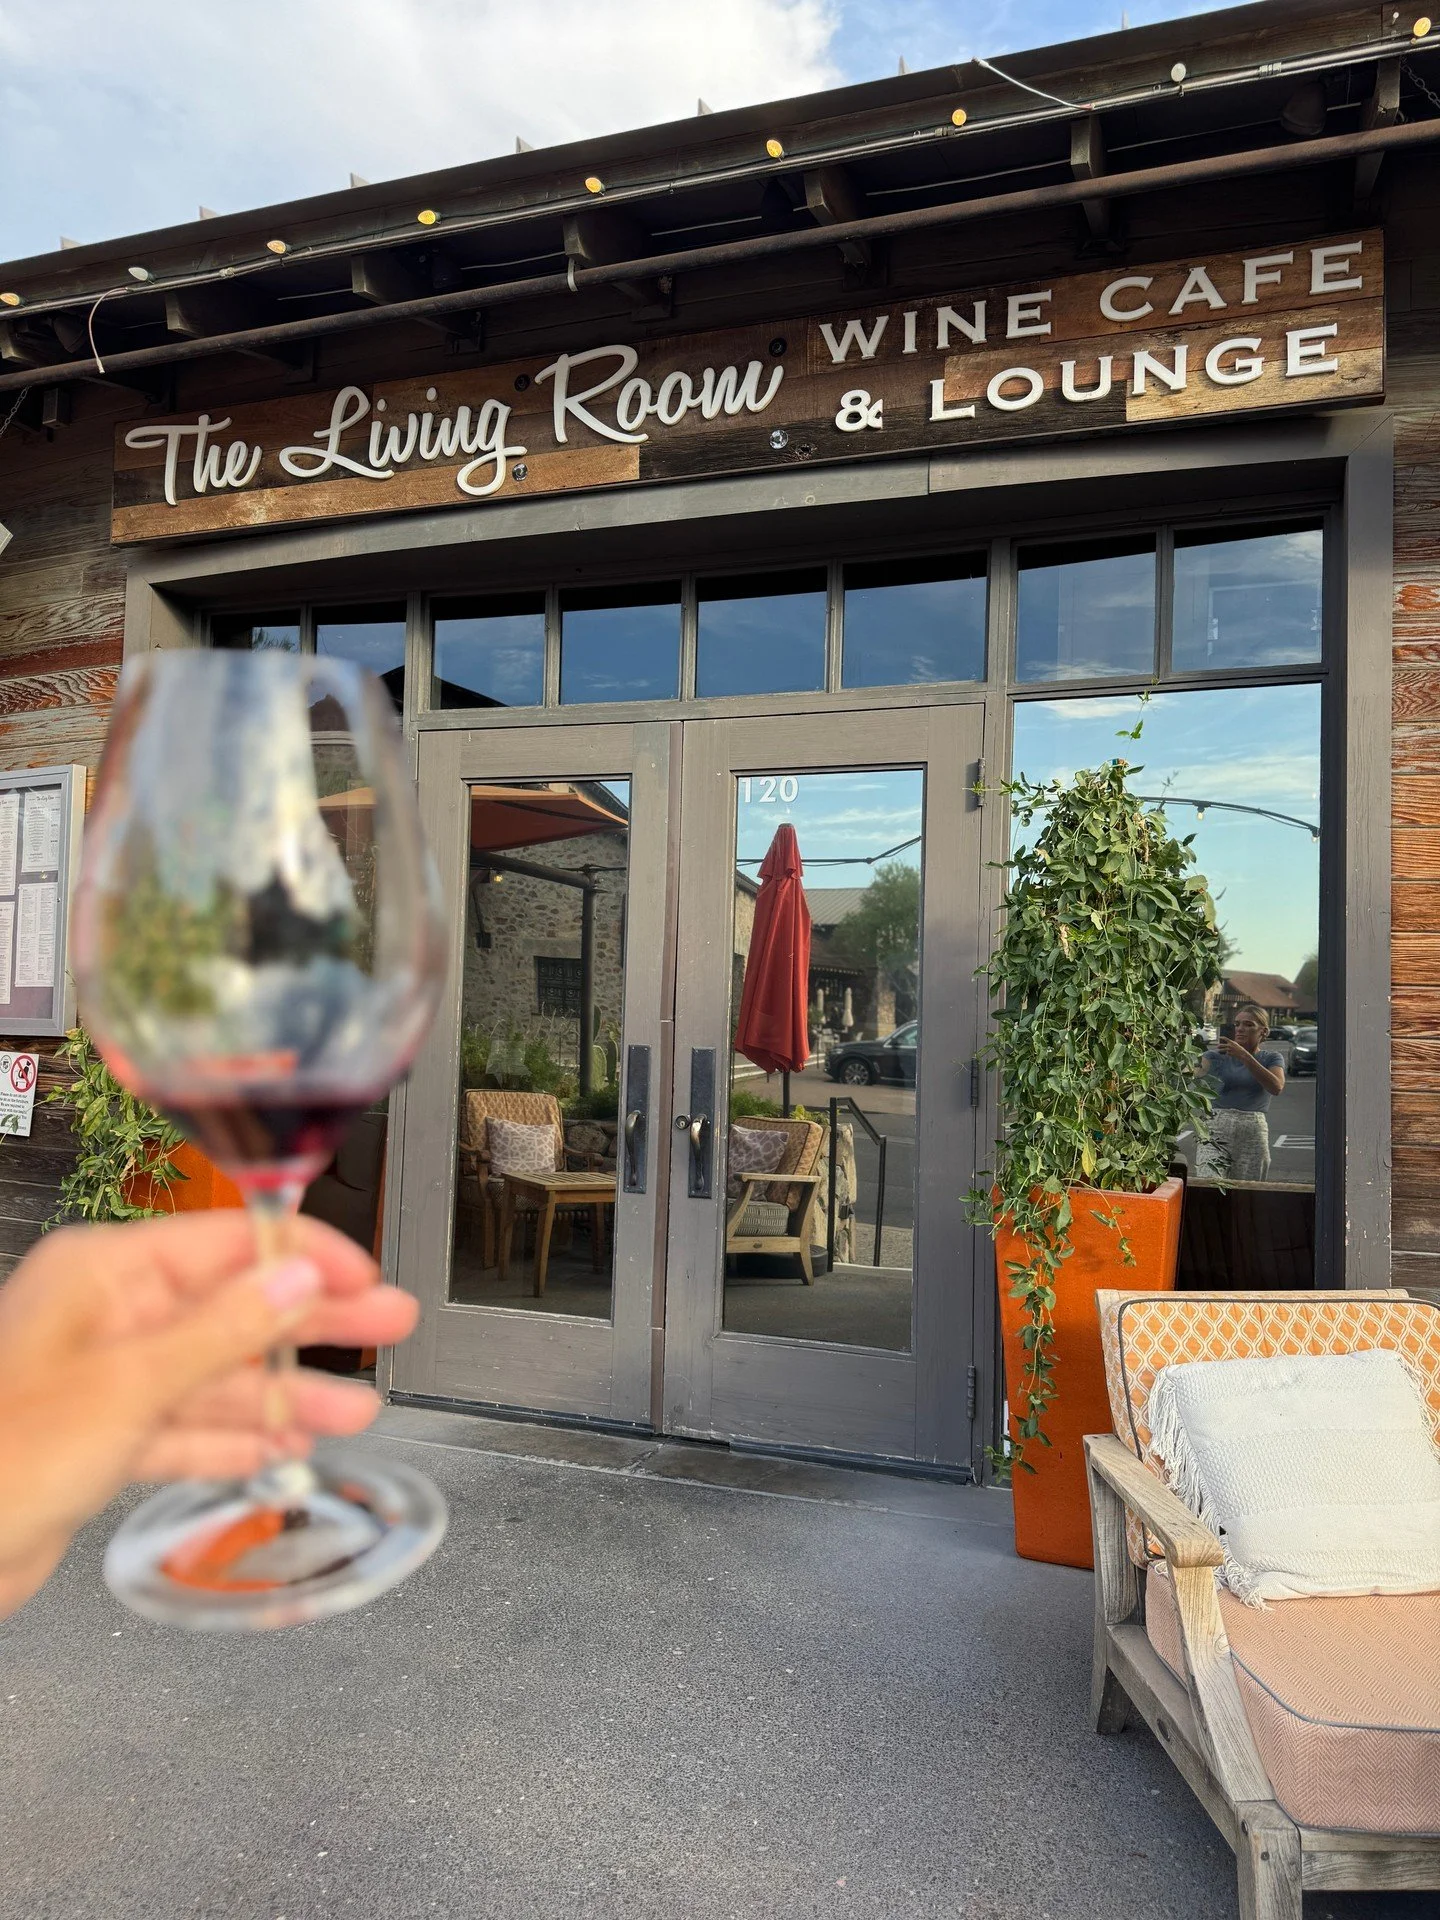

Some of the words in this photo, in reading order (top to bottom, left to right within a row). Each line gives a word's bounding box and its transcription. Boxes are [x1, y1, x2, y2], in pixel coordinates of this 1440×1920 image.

[819, 289, 1052, 364] WINE
[1099, 240, 1363, 322] CAFE
[125, 414, 262, 506] The
[279, 386, 527, 496] Living
[535, 345, 784, 443] Room
[834, 389, 883, 432] &
[930, 323, 1338, 422] LOUNGE
[740, 775, 799, 803] 120
